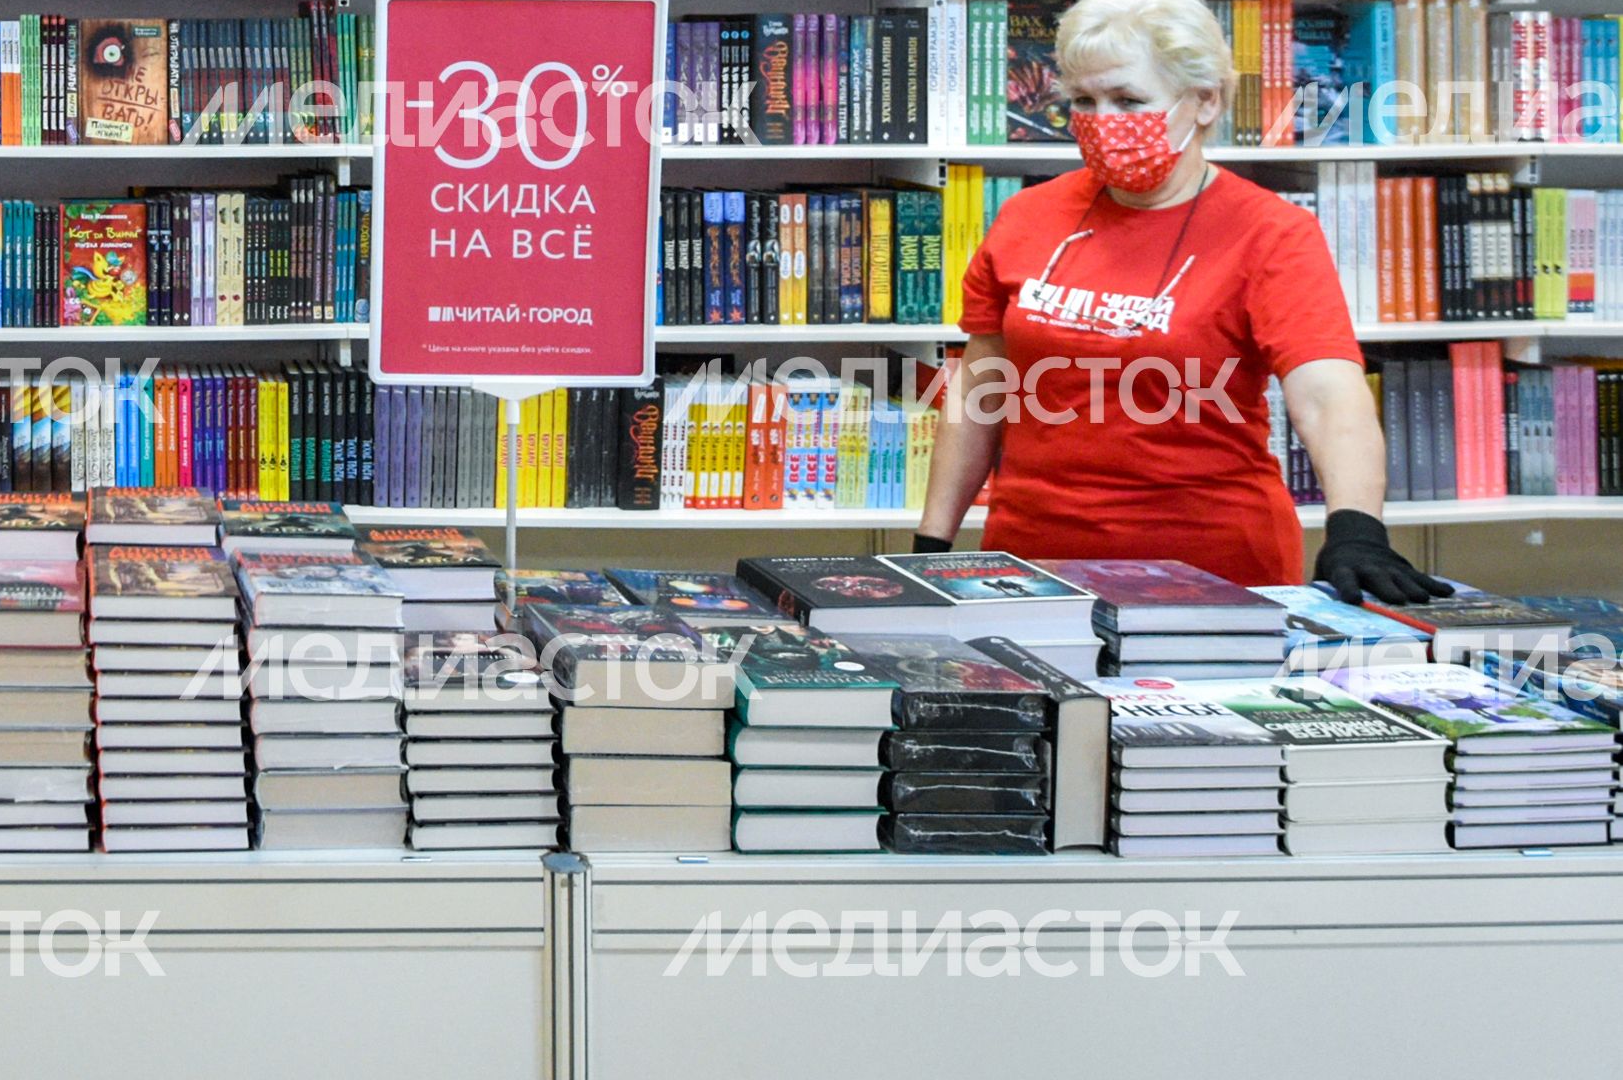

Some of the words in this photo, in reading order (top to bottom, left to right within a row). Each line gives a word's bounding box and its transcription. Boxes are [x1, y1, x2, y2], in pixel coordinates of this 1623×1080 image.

[930, 17, 939, 52] РАМЗИ
[948, 17, 957, 52] РАМЗИ
[930, 53, 939, 93] ГОРДОН
[948, 53, 957, 93] ГОРДОН
[102, 103, 155, 131] ВАТЬ!
[430, 183, 597, 219] СКИДКА
[430, 228, 492, 259] НА
[512, 223, 593, 260] ВСЁ
[428, 344, 450, 354] Цена
[520, 344, 536, 353] без
[789, 454, 800, 484] ВСЕ
[807, 454, 817, 484] ВСЕ
[1283, 724, 1414, 739] БЕЛИЗНА
